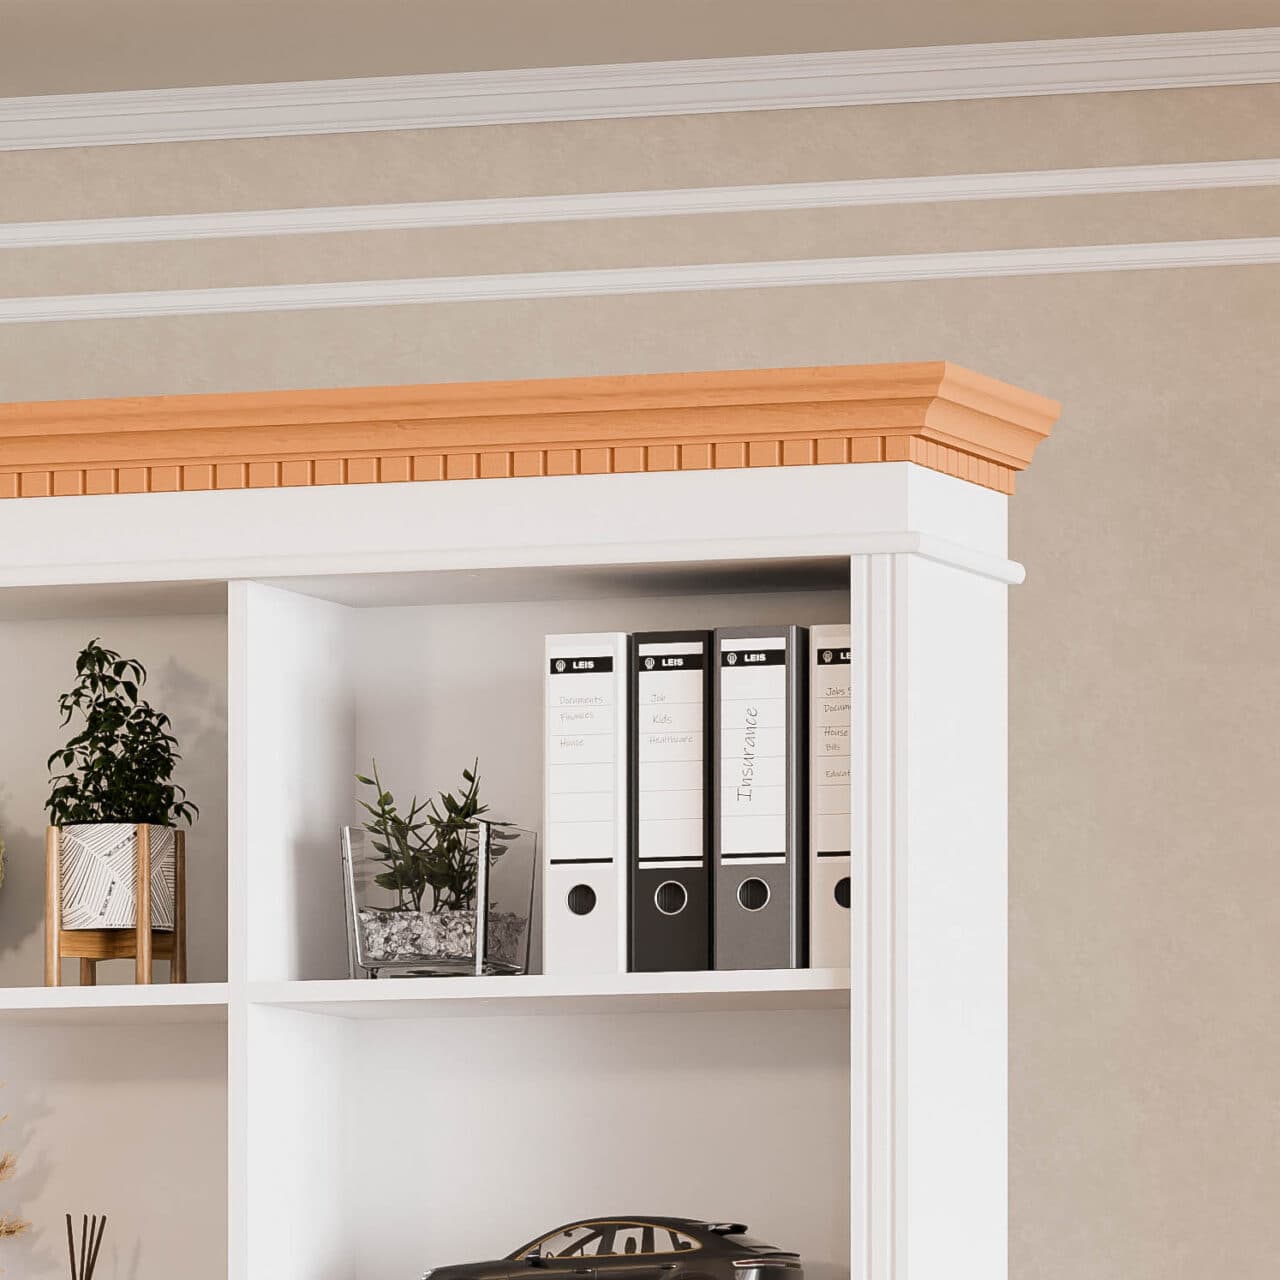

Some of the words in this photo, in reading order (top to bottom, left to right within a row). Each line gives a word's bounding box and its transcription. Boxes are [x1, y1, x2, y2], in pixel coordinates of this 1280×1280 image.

[744, 653, 767, 662] LEIS
[572, 661, 595, 670] LEIS
[662, 658, 685, 667] LEIS
[559, 696, 604, 705] Documents
[824, 728, 849, 737] House
[737, 708, 758, 802] Insurance
